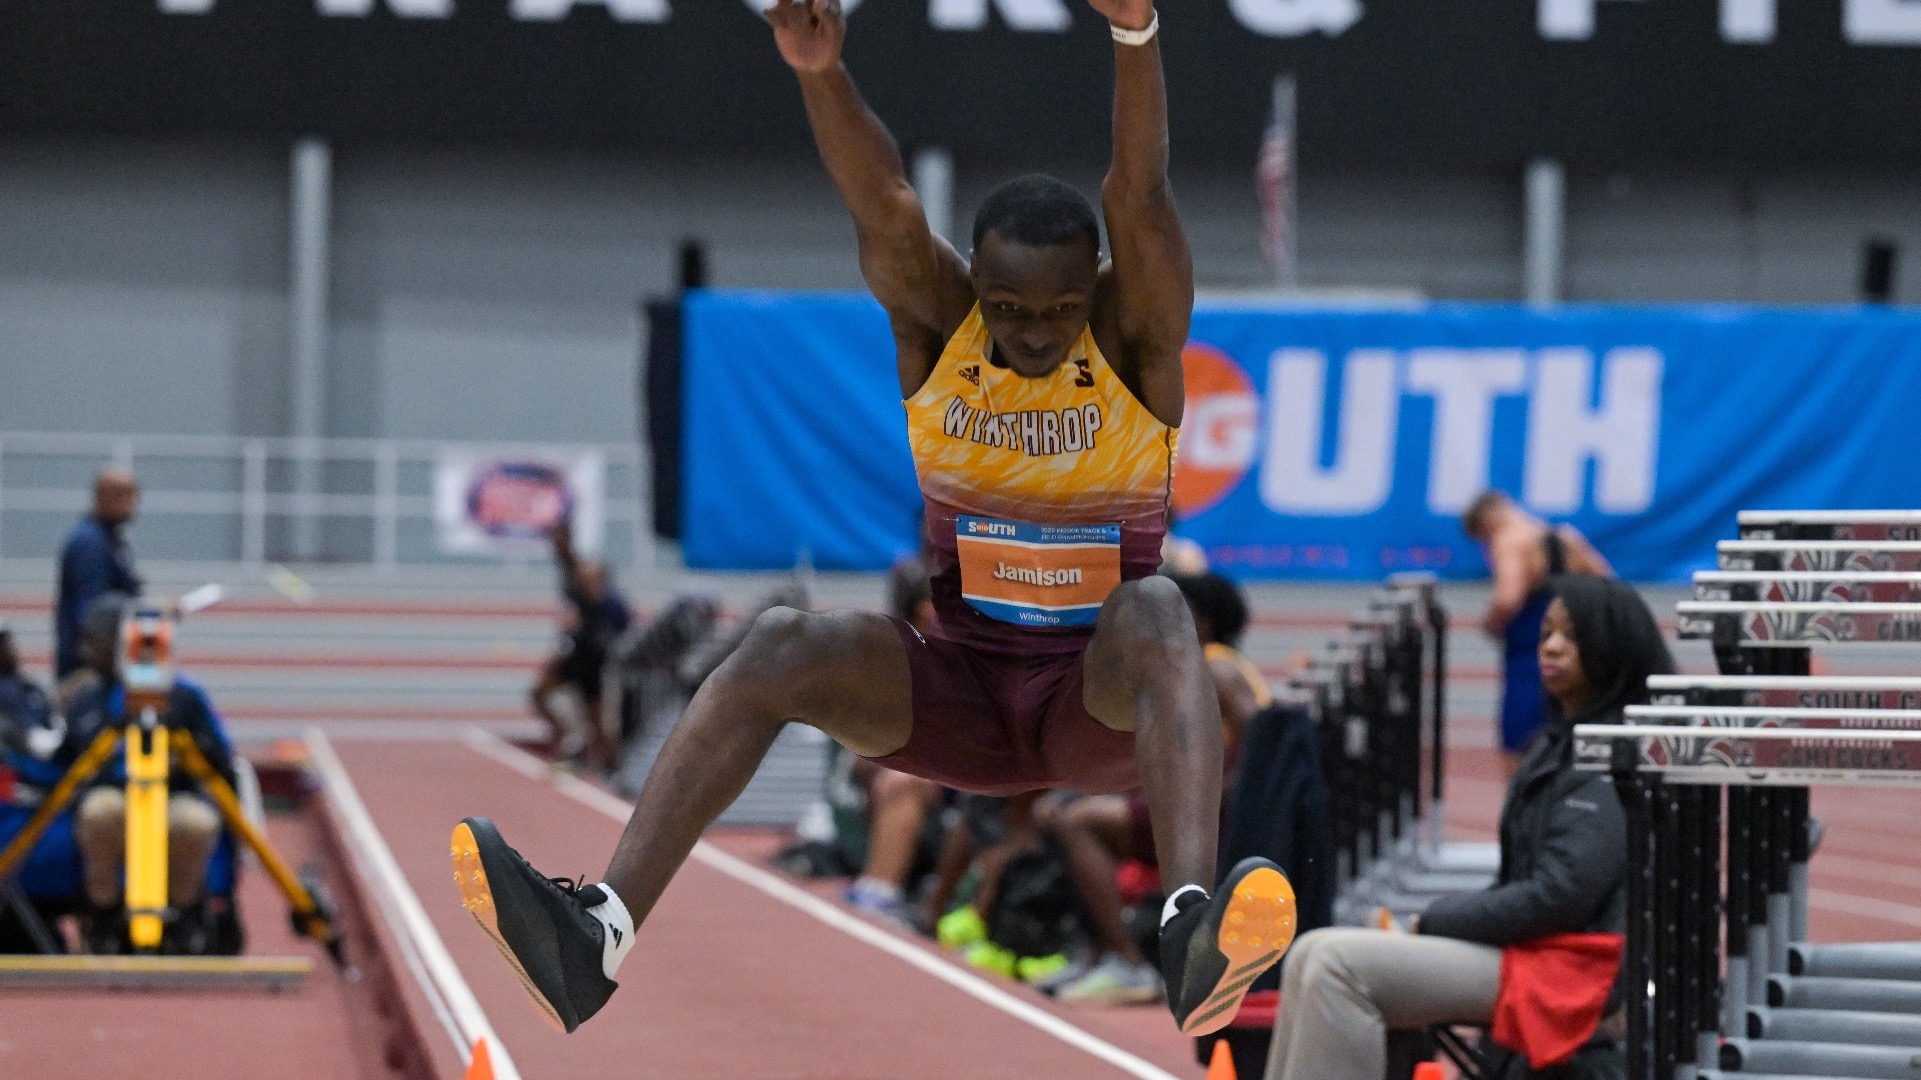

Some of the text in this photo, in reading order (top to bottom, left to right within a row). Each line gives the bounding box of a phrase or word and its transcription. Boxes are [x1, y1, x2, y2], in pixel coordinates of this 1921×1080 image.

[943, 394, 1102, 457] WINTHROP
[1257, 346, 1667, 516] UTH
[993, 562, 1083, 587] Jamison
[1019, 612, 1060, 624] Winthrop
